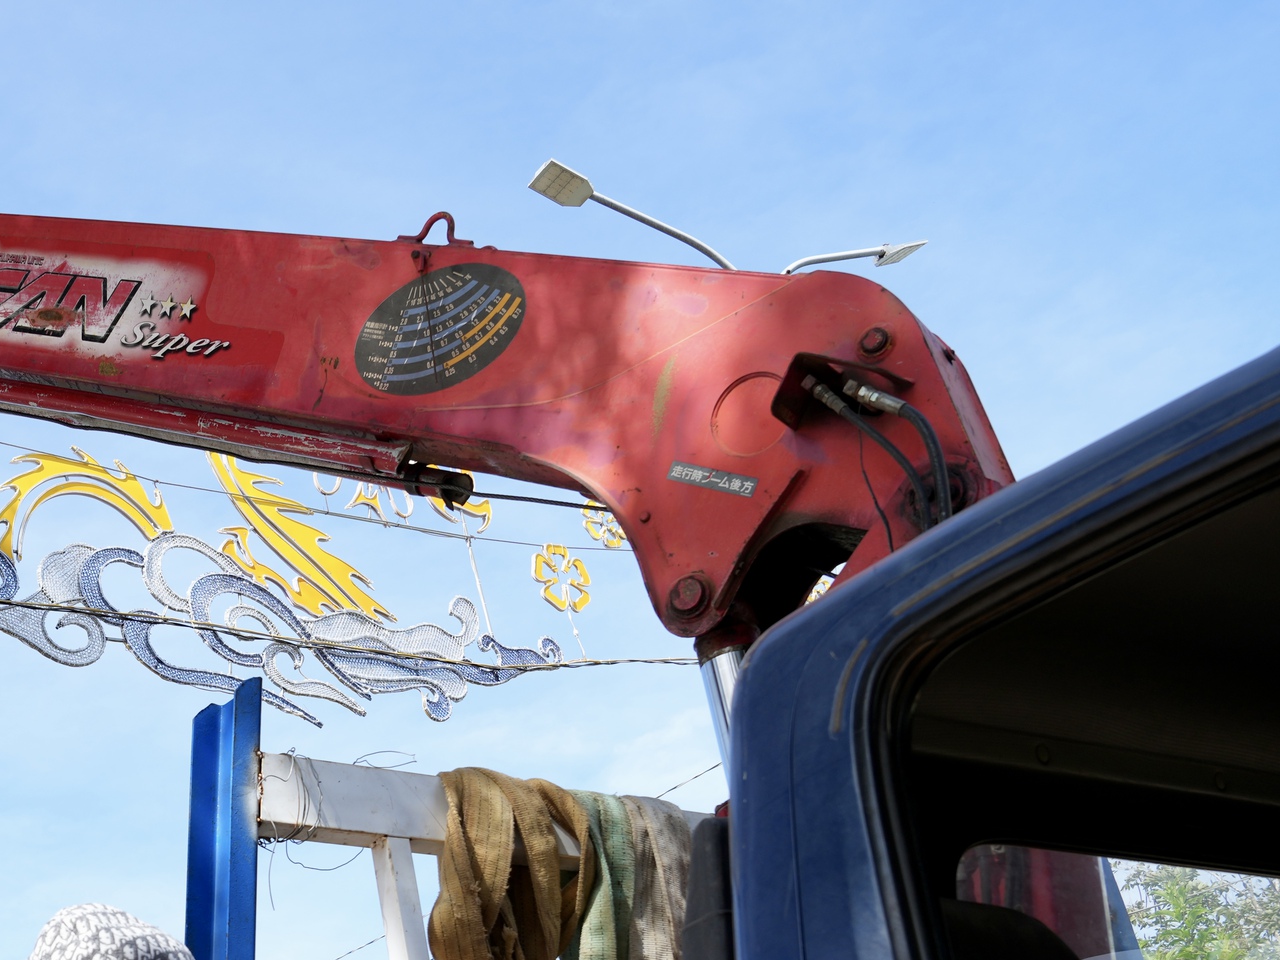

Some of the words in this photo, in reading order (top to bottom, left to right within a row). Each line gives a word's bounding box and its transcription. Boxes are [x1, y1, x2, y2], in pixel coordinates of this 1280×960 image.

[121, 320, 232, 361] Super
[670, 465, 755, 494] 走行時ブーム後方
